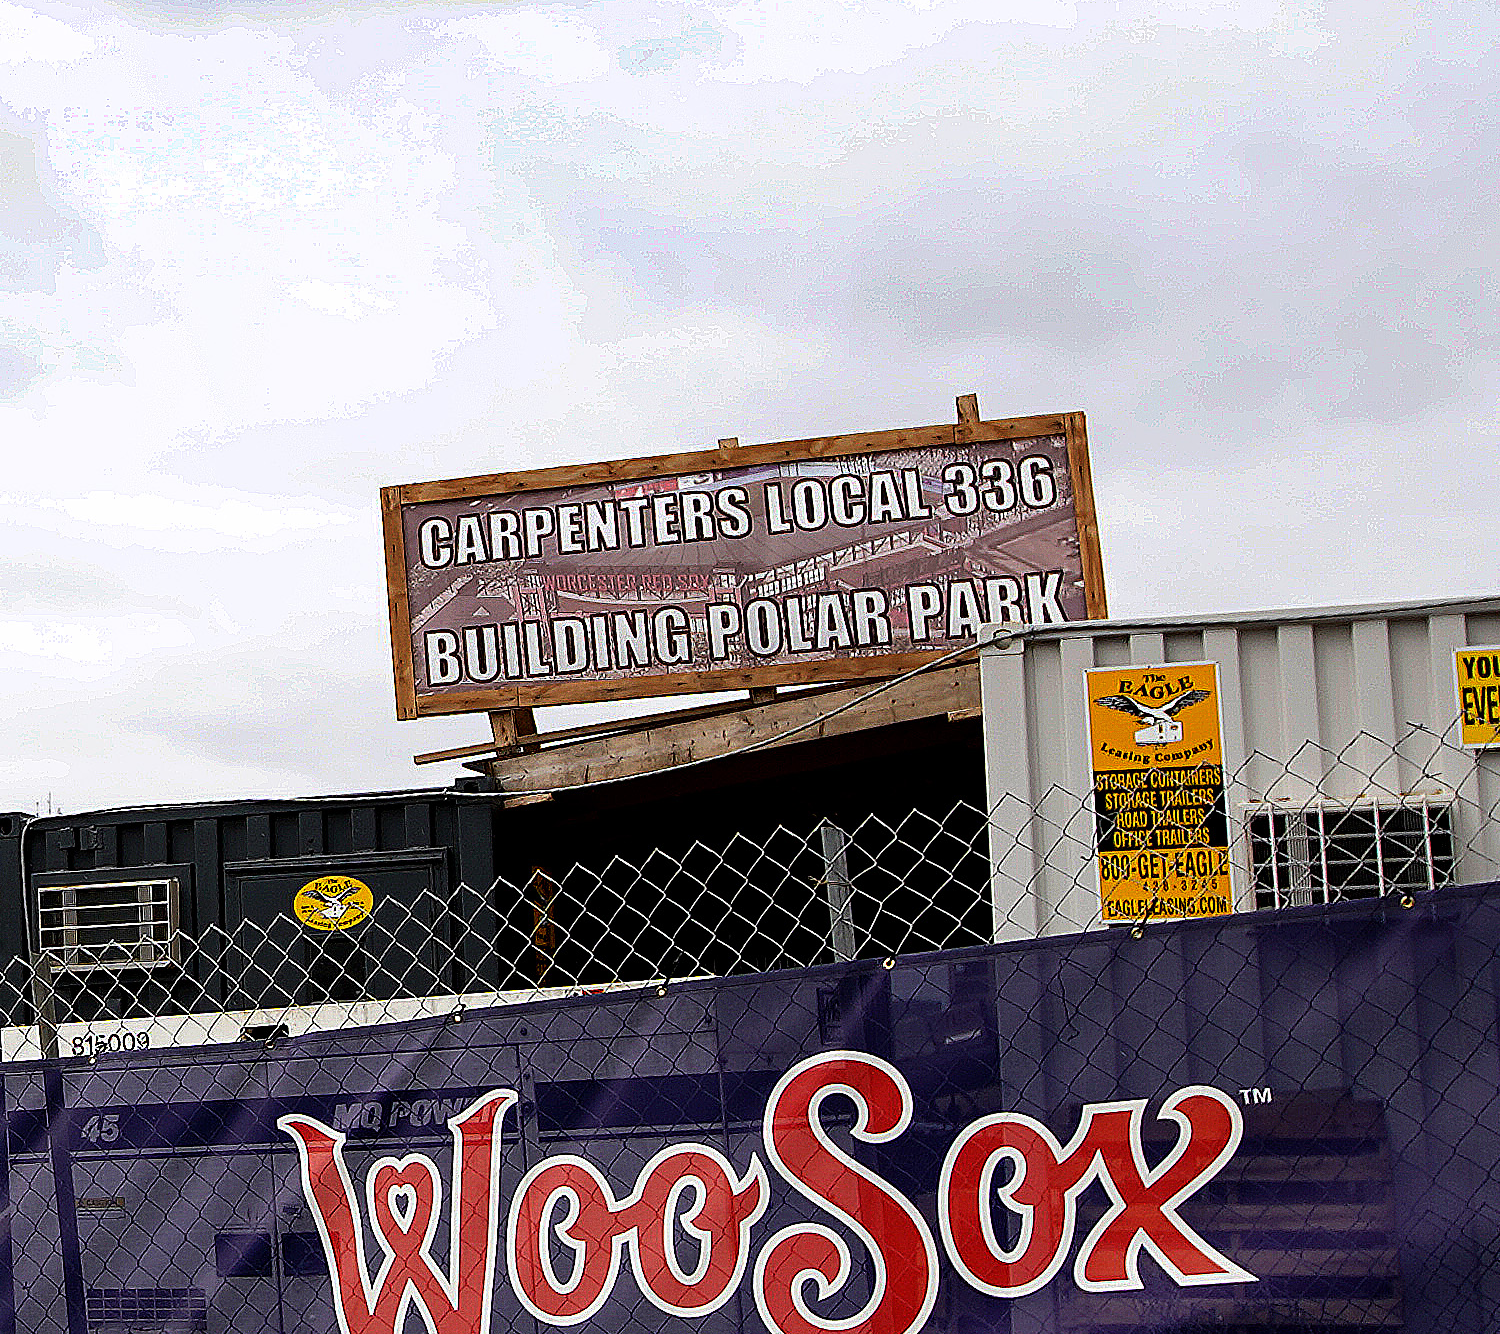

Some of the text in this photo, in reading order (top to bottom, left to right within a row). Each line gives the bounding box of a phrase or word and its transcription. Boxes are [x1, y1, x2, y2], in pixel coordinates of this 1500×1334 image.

[419, 452, 1059, 569] CARPENTERS LOCAL 336
[425, 569, 1072, 688] BUILDING POLAR PARK
[1119, 676, 1194, 699] EAGLE
[1143, 674, 1166, 683] The
[1100, 738, 1214, 765] Leasing Company
[1096, 769, 1221, 791] STORAGE CONTAINERS
[1105, 788, 1214, 810] STORAGE TRAILERS
[1117, 808, 1205, 829] ROAD TRAILERS
[1114, 827, 1210, 848] OFFICE TRAILERS
[72, 1031, 150, 1057] 815009
[81, 1114, 120, 1142] 45
